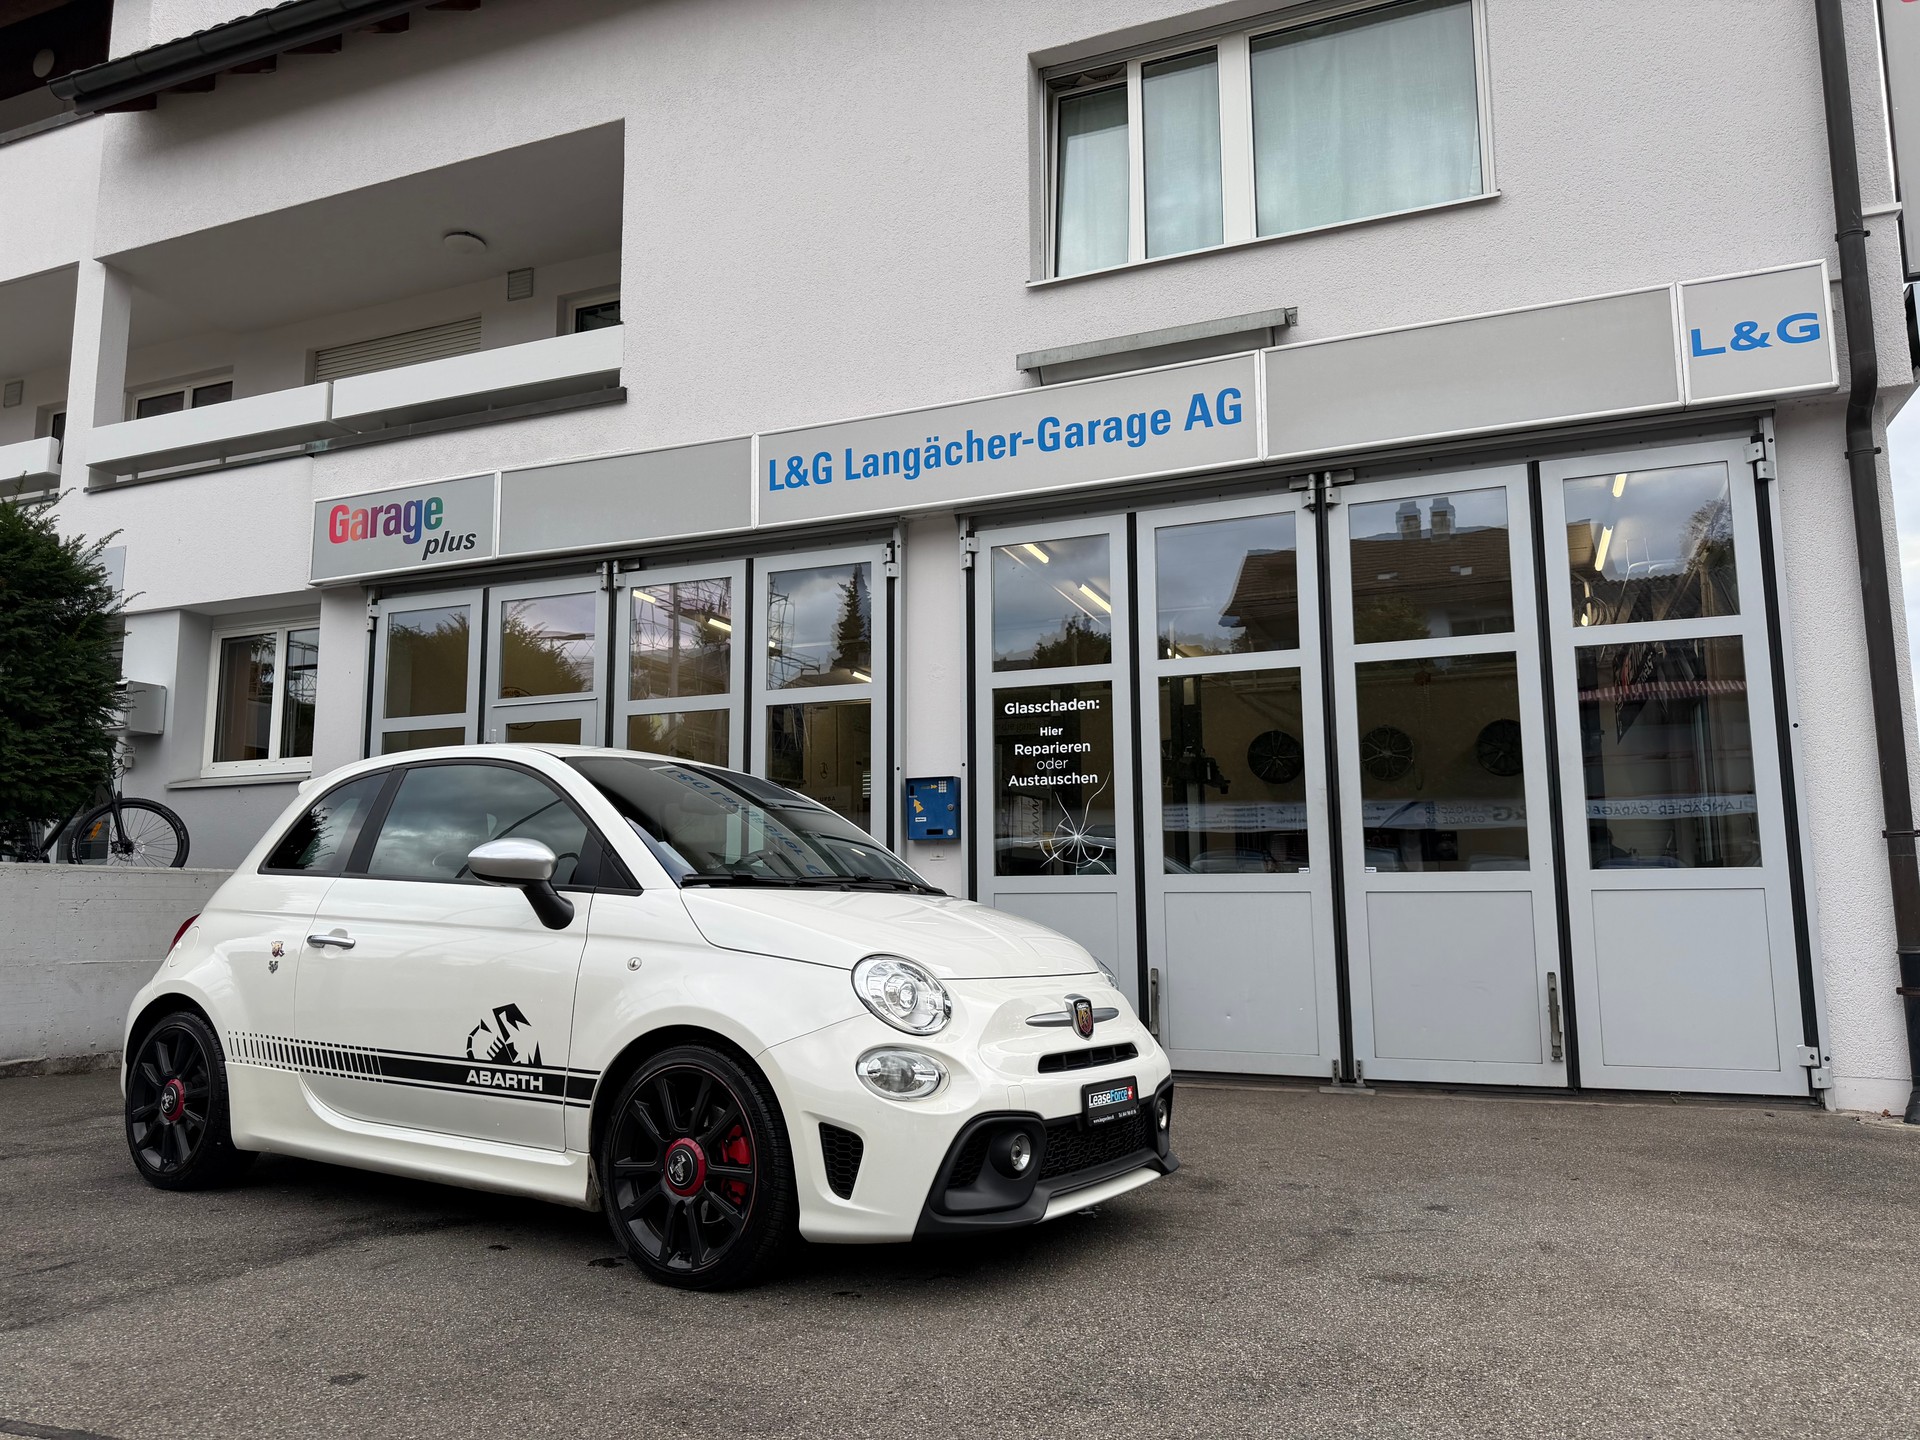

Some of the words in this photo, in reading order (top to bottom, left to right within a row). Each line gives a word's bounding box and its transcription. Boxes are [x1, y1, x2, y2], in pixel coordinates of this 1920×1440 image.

[1690, 312, 1821, 358] L&G
[768, 451, 832, 492] L&G
[844, 408, 1172, 481] Langächer-Garage
[1183, 387, 1243, 432] AG
[328, 496, 443, 545] Garage
[421, 531, 477, 560] plus
[1004, 698, 1100, 715] Glasschaden:
[1039, 726, 1063, 736] Hier
[1014, 742, 1091, 757] Reparieren
[1036, 757, 1068, 770] oder
[1008, 772, 1098, 787] Austauschen
[466, 1069, 543, 1091] ABARTH
[1089, 1089, 1128, 1107] LeaseForce
